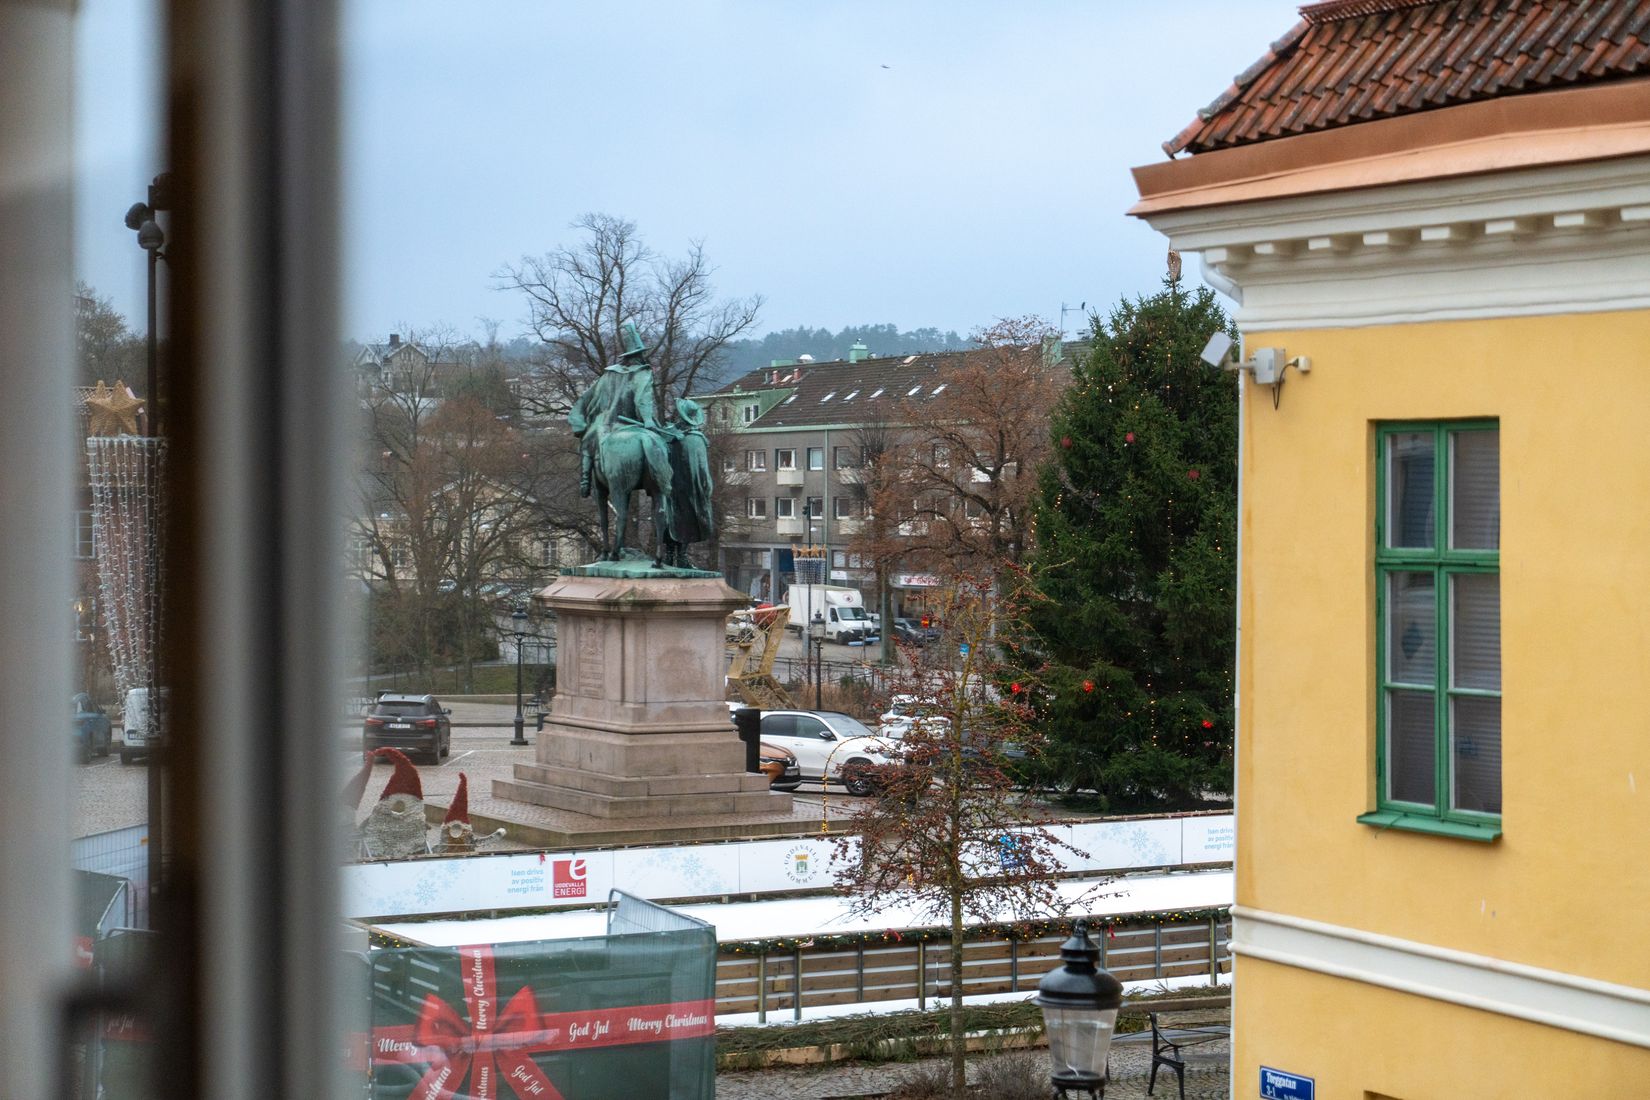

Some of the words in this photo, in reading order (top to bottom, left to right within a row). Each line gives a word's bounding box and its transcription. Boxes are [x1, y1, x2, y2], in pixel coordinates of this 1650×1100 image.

[507, 887, 529, 895] energi
[520, 877, 544, 886] positiv
[554, 887, 585, 896] ENERGI
[569, 1022, 589, 1043] God
[592, 1019, 610, 1041] Jul
[626, 1016, 663, 1035] Merry
[664, 1012, 708, 1029] Christmas
[377, 1038, 418, 1057] Merry
[511, 1064, 533, 1083] God
[524, 1080, 544, 1096] Jul
[1265, 1071, 1297, 1090] Torggatan
